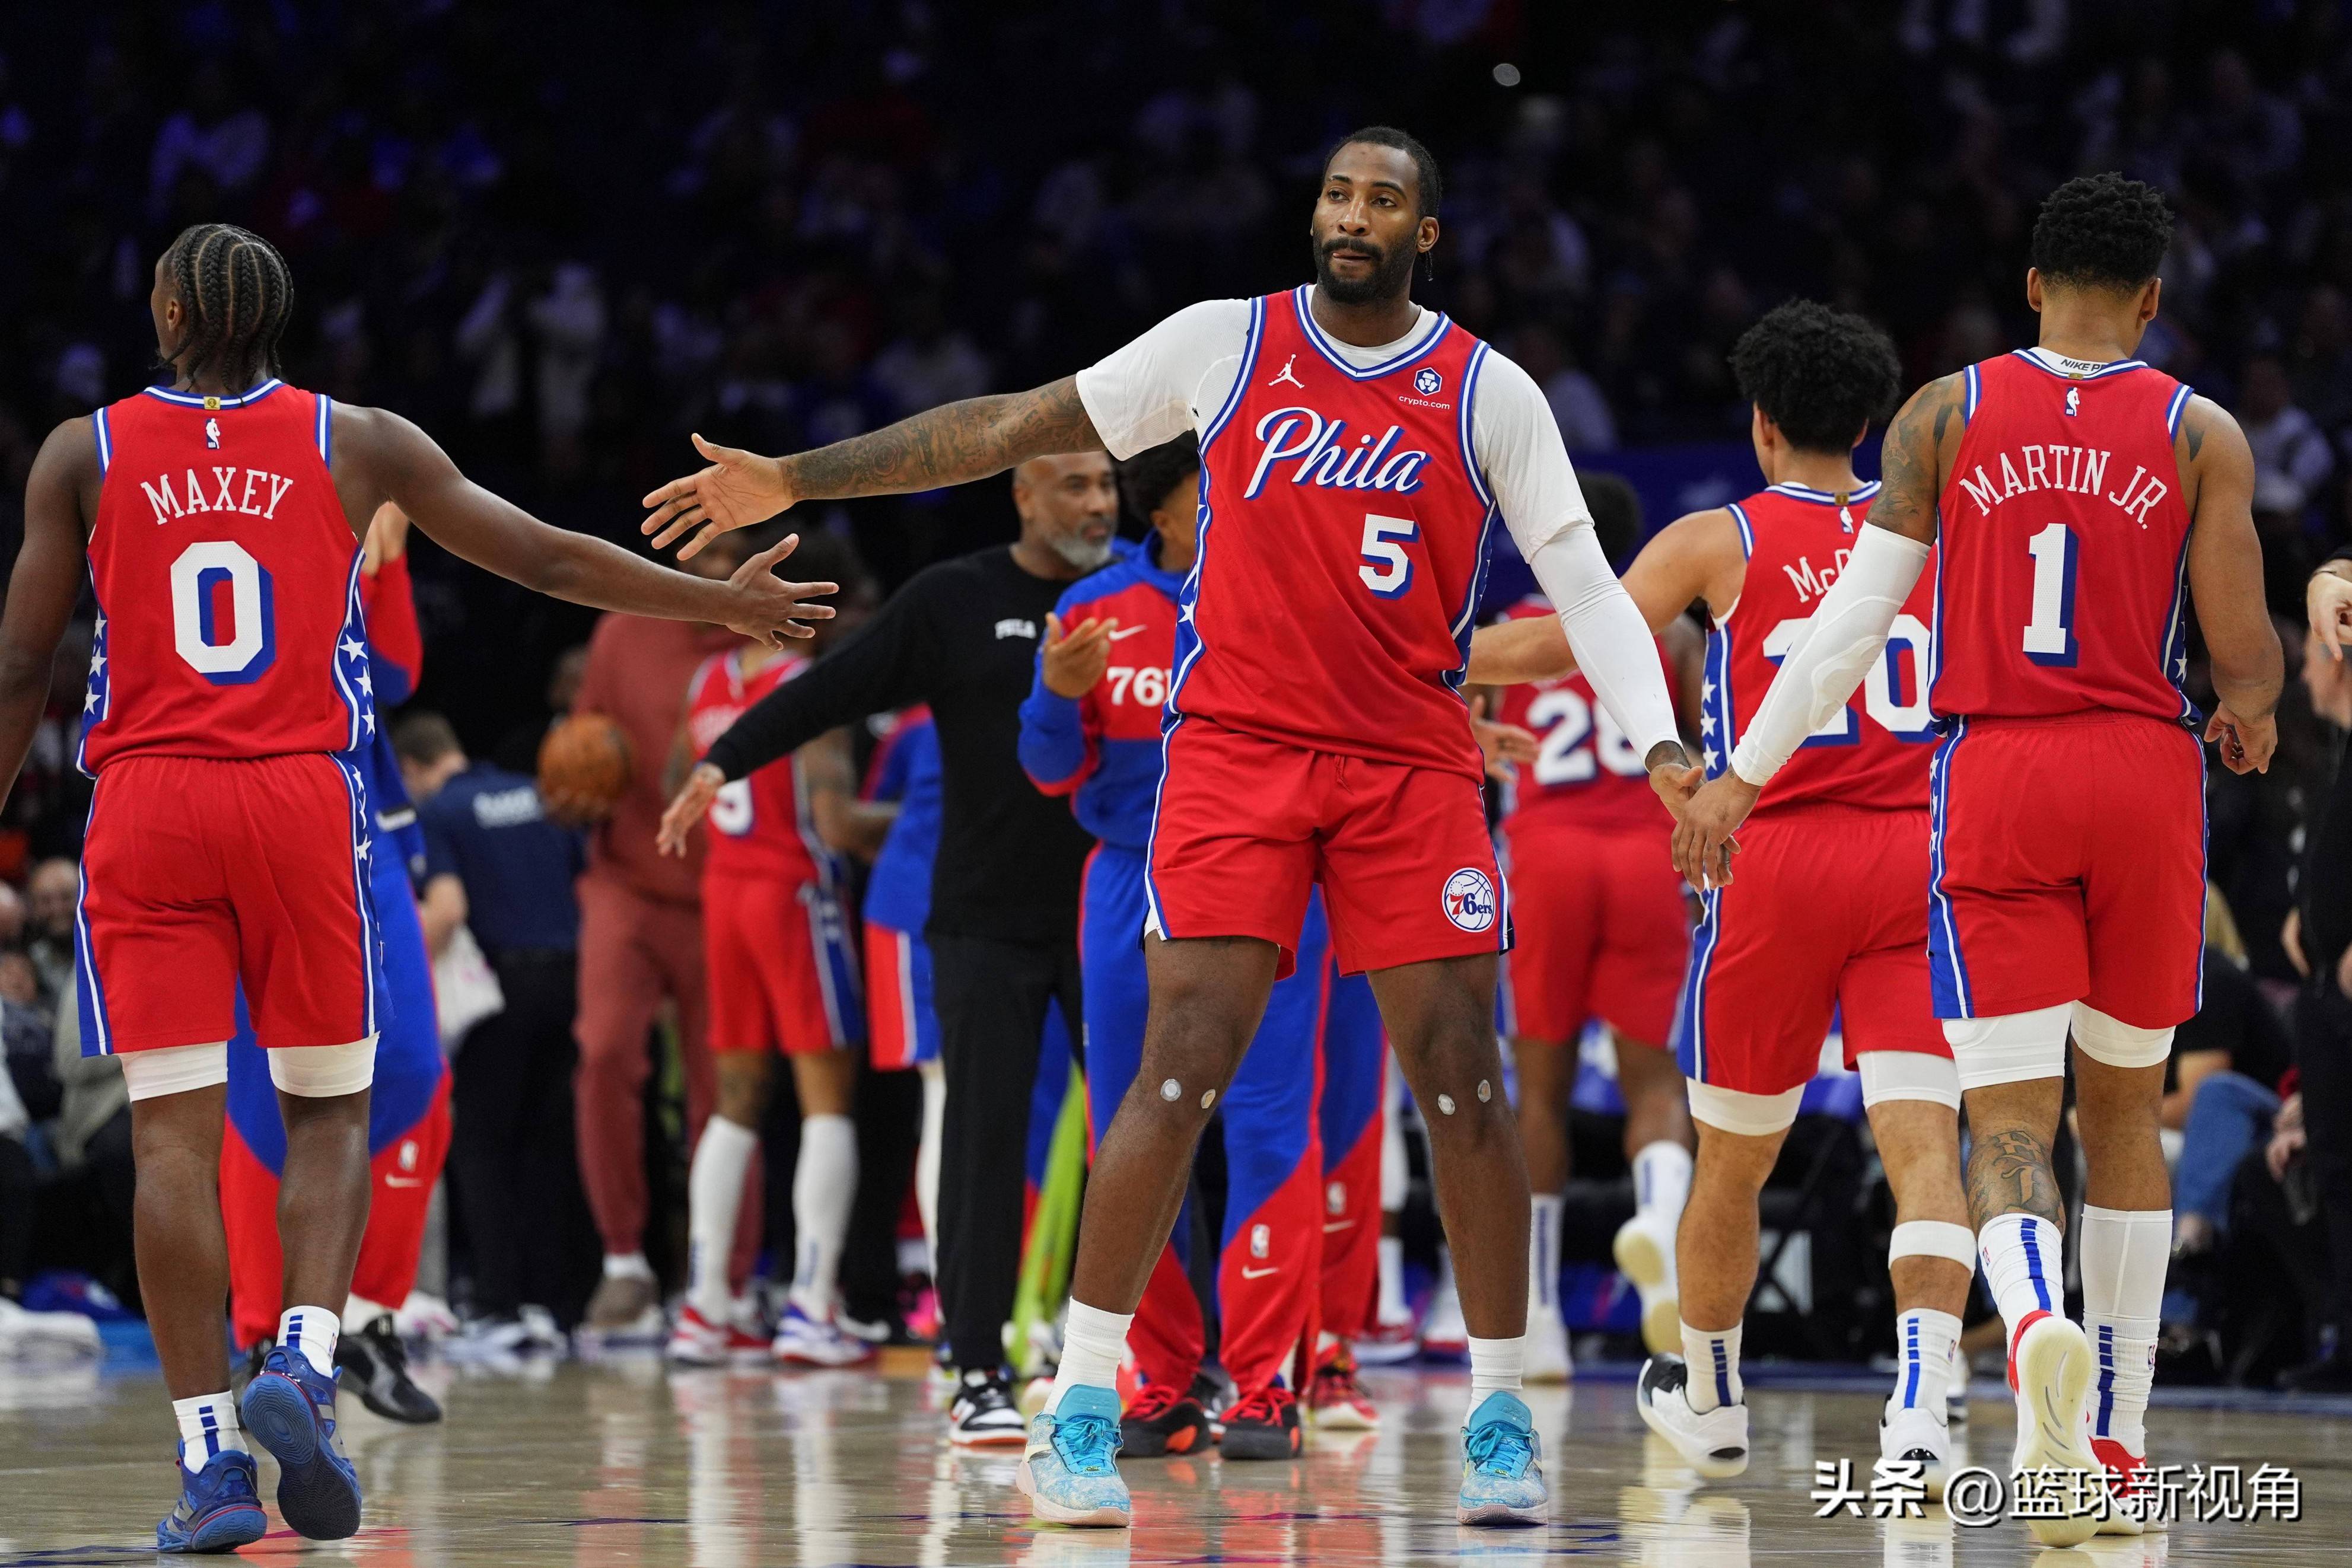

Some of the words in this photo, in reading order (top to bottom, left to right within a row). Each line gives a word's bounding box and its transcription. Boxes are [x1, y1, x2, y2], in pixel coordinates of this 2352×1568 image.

[2061, 359, 2089, 371] NIKE
[1399, 396, 1450, 410] crypto.com
[1244, 407, 1429, 499] Phila
[1959, 445, 2111, 517] MARTIN
[2109, 465, 2168, 530] JR.
[141, 467, 294, 525] MAXEY
[1358, 513, 1417, 596] 5
[170, 541, 270, 679] 0
[2023, 523, 2073, 660] 1
[1106, 666, 1172, 707] 76
[1450, 893, 1493, 915] 76ers
